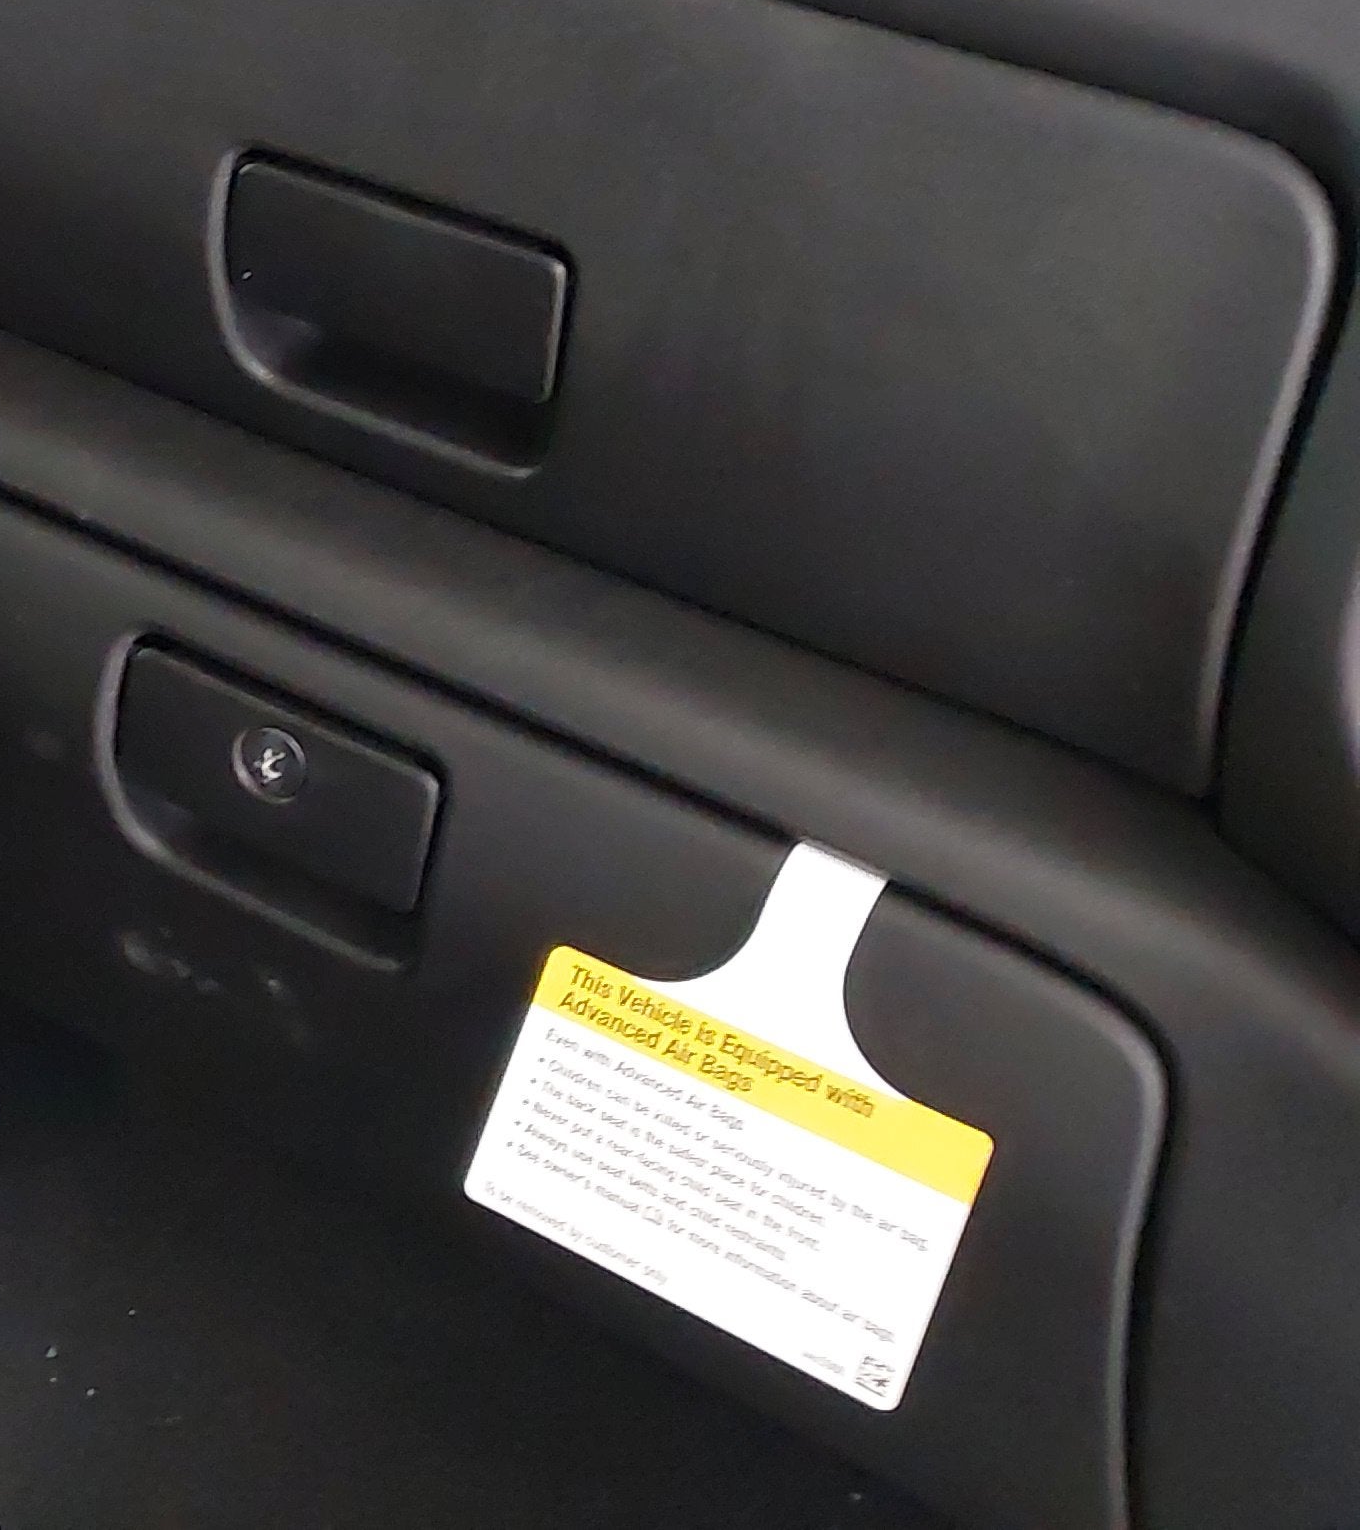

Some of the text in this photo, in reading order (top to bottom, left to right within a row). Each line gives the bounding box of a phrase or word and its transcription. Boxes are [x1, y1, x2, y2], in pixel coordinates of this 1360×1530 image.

[548, 1058, 601, 1093] Children
[558, 990, 753, 1092] Advanced Air Bags
[570, 964, 874, 1118] This Vehicle is Equipped with
[612, 1060, 683, 1101] Advanced
